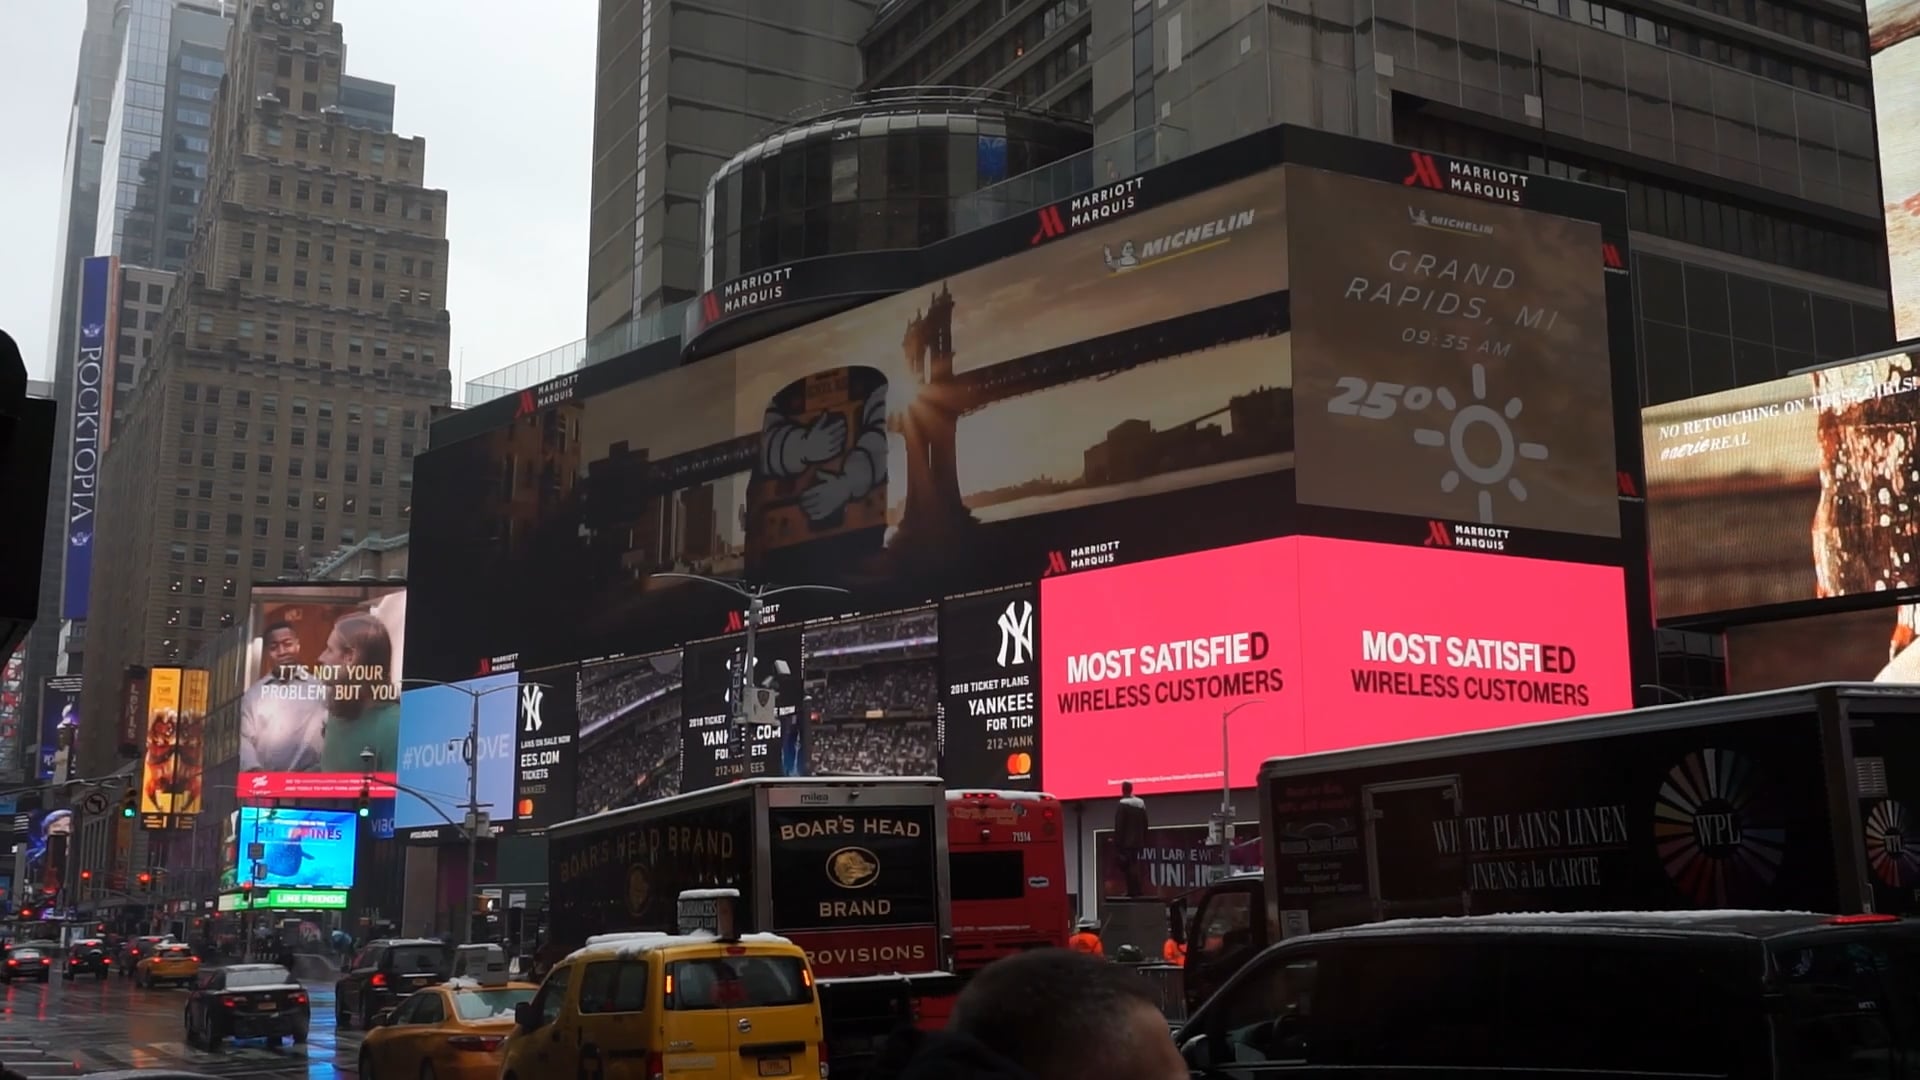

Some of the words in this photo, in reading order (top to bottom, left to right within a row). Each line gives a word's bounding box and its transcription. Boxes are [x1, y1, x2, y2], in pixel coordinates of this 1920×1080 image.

[1450, 161, 1529, 188] MARRIOTT
[1071, 177, 1144, 212] MARRIOTT
[1450, 178, 1521, 202] MARQUIS
[1071, 196, 1135, 228] MARQUIS
[1431, 215, 1494, 235] MICHELIN
[1142, 209, 1255, 259] MICHELIN
[724, 267, 793, 297] MARRIOTT
[1388, 250, 1516, 290] GRAND
[724, 286, 783, 313] MARQUIS
[1345, 277, 1493, 326] RAPIDS,
[1515, 305, 1559, 332] MI
[1401, 328, 1469, 352] 09:35
[1478, 340, 1511, 357] AM
[537, 388, 574, 408] MARQUIS
[538, 374, 579, 395] MARRIOTT
[1658, 423, 1680, 442] NO
[1683, 404, 1780, 435] RETOUCHING
[1784, 398, 1806, 415] ON
[71, 346, 102, 523] ROCKTOPIA
[1455, 524, 1510, 539] MARRIOTT
[1455, 536, 1505, 551] MARQUIS
[1070, 540, 1121, 557] MARRIOTT
[1070, 552, 1115, 569] MARQUIS
[744, 604, 780, 618] MIOTT
[744, 615, 776, 627] MUIS
[1067, 647, 1137, 684] MOST
[1140, 631, 1269, 675] SATISFIED
[1362, 630, 1442, 666] MOST
[1446, 635, 1576, 674] SATISFIED
[279, 664, 309, 681] IT'S
[314, 664, 341, 681] NOT
[346, 664, 384, 681] YOUR
[950, 684, 969, 695] 2018
[970, 679, 999, 692] TICKET
[1000, 675, 1029, 689] PLANS
[260, 685, 327, 701] PROBLEM
[334, 684, 362, 701] BUT
[370, 684, 397, 700] YOU
[1057, 684, 1151, 715] WIRELESS
[1155, 668, 1284, 705] CUSTOMERS
[1351, 668, 1460, 699] WIRELESS
[1464, 676, 1590, 708] CUSTOMERS
[968, 692, 1034, 716] YANKEES
[704, 714, 726, 725] TICKET
[986, 717, 1008, 731] FOR
[521, 768, 549, 780] TICKETS
[781, 814, 855, 841] BOAR'S
[863, 818, 921, 839] HEAD
[1432, 816, 1489, 854] WHTE
[1493, 811, 1561, 850] PLAINS
[1565, 805, 1629, 846] LINEN
[1695, 812, 1741, 848] WPL
[617, 829, 660, 857] HEAD
[668, 827, 733, 860] BRAND
[1533, 860, 1546, 888] la
[1549, 857, 1600, 888] CARTE
[819, 900, 891, 917] BRAND
[804, 944, 926, 967] ROVISIONS
